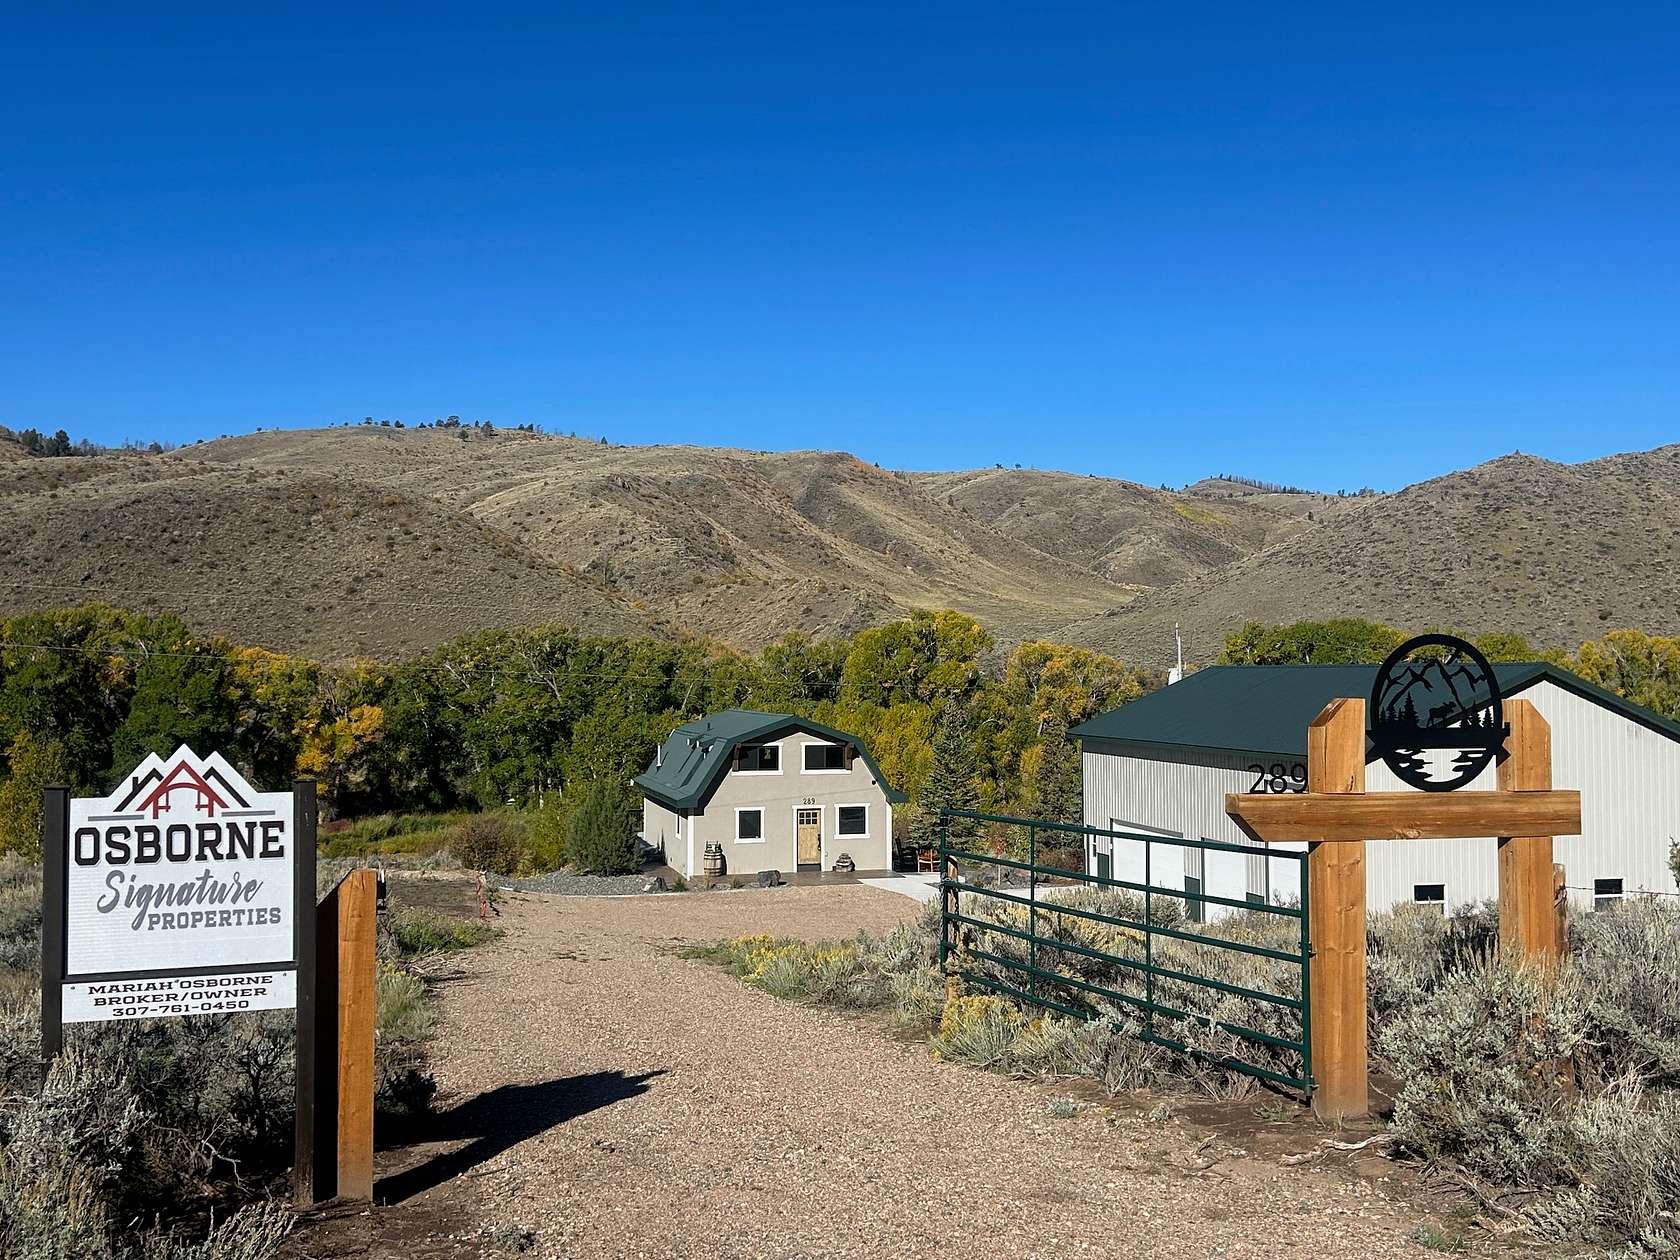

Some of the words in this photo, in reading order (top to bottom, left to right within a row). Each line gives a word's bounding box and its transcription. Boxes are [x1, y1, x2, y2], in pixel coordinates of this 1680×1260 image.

[1248, 764, 1308, 794] 289
[802, 797, 816, 805] 289
[74, 820, 285, 866] OSBORNE
[97, 868, 263, 931] Signature
[147, 907, 281, 931] PROPERTIES
[88, 983, 172, 995] MARIAH
[180, 975, 273, 989] OSBORNE
[94, 988, 267, 1006] BROKER/OWNER
[112, 1000, 249, 1017] 307-761-0450
